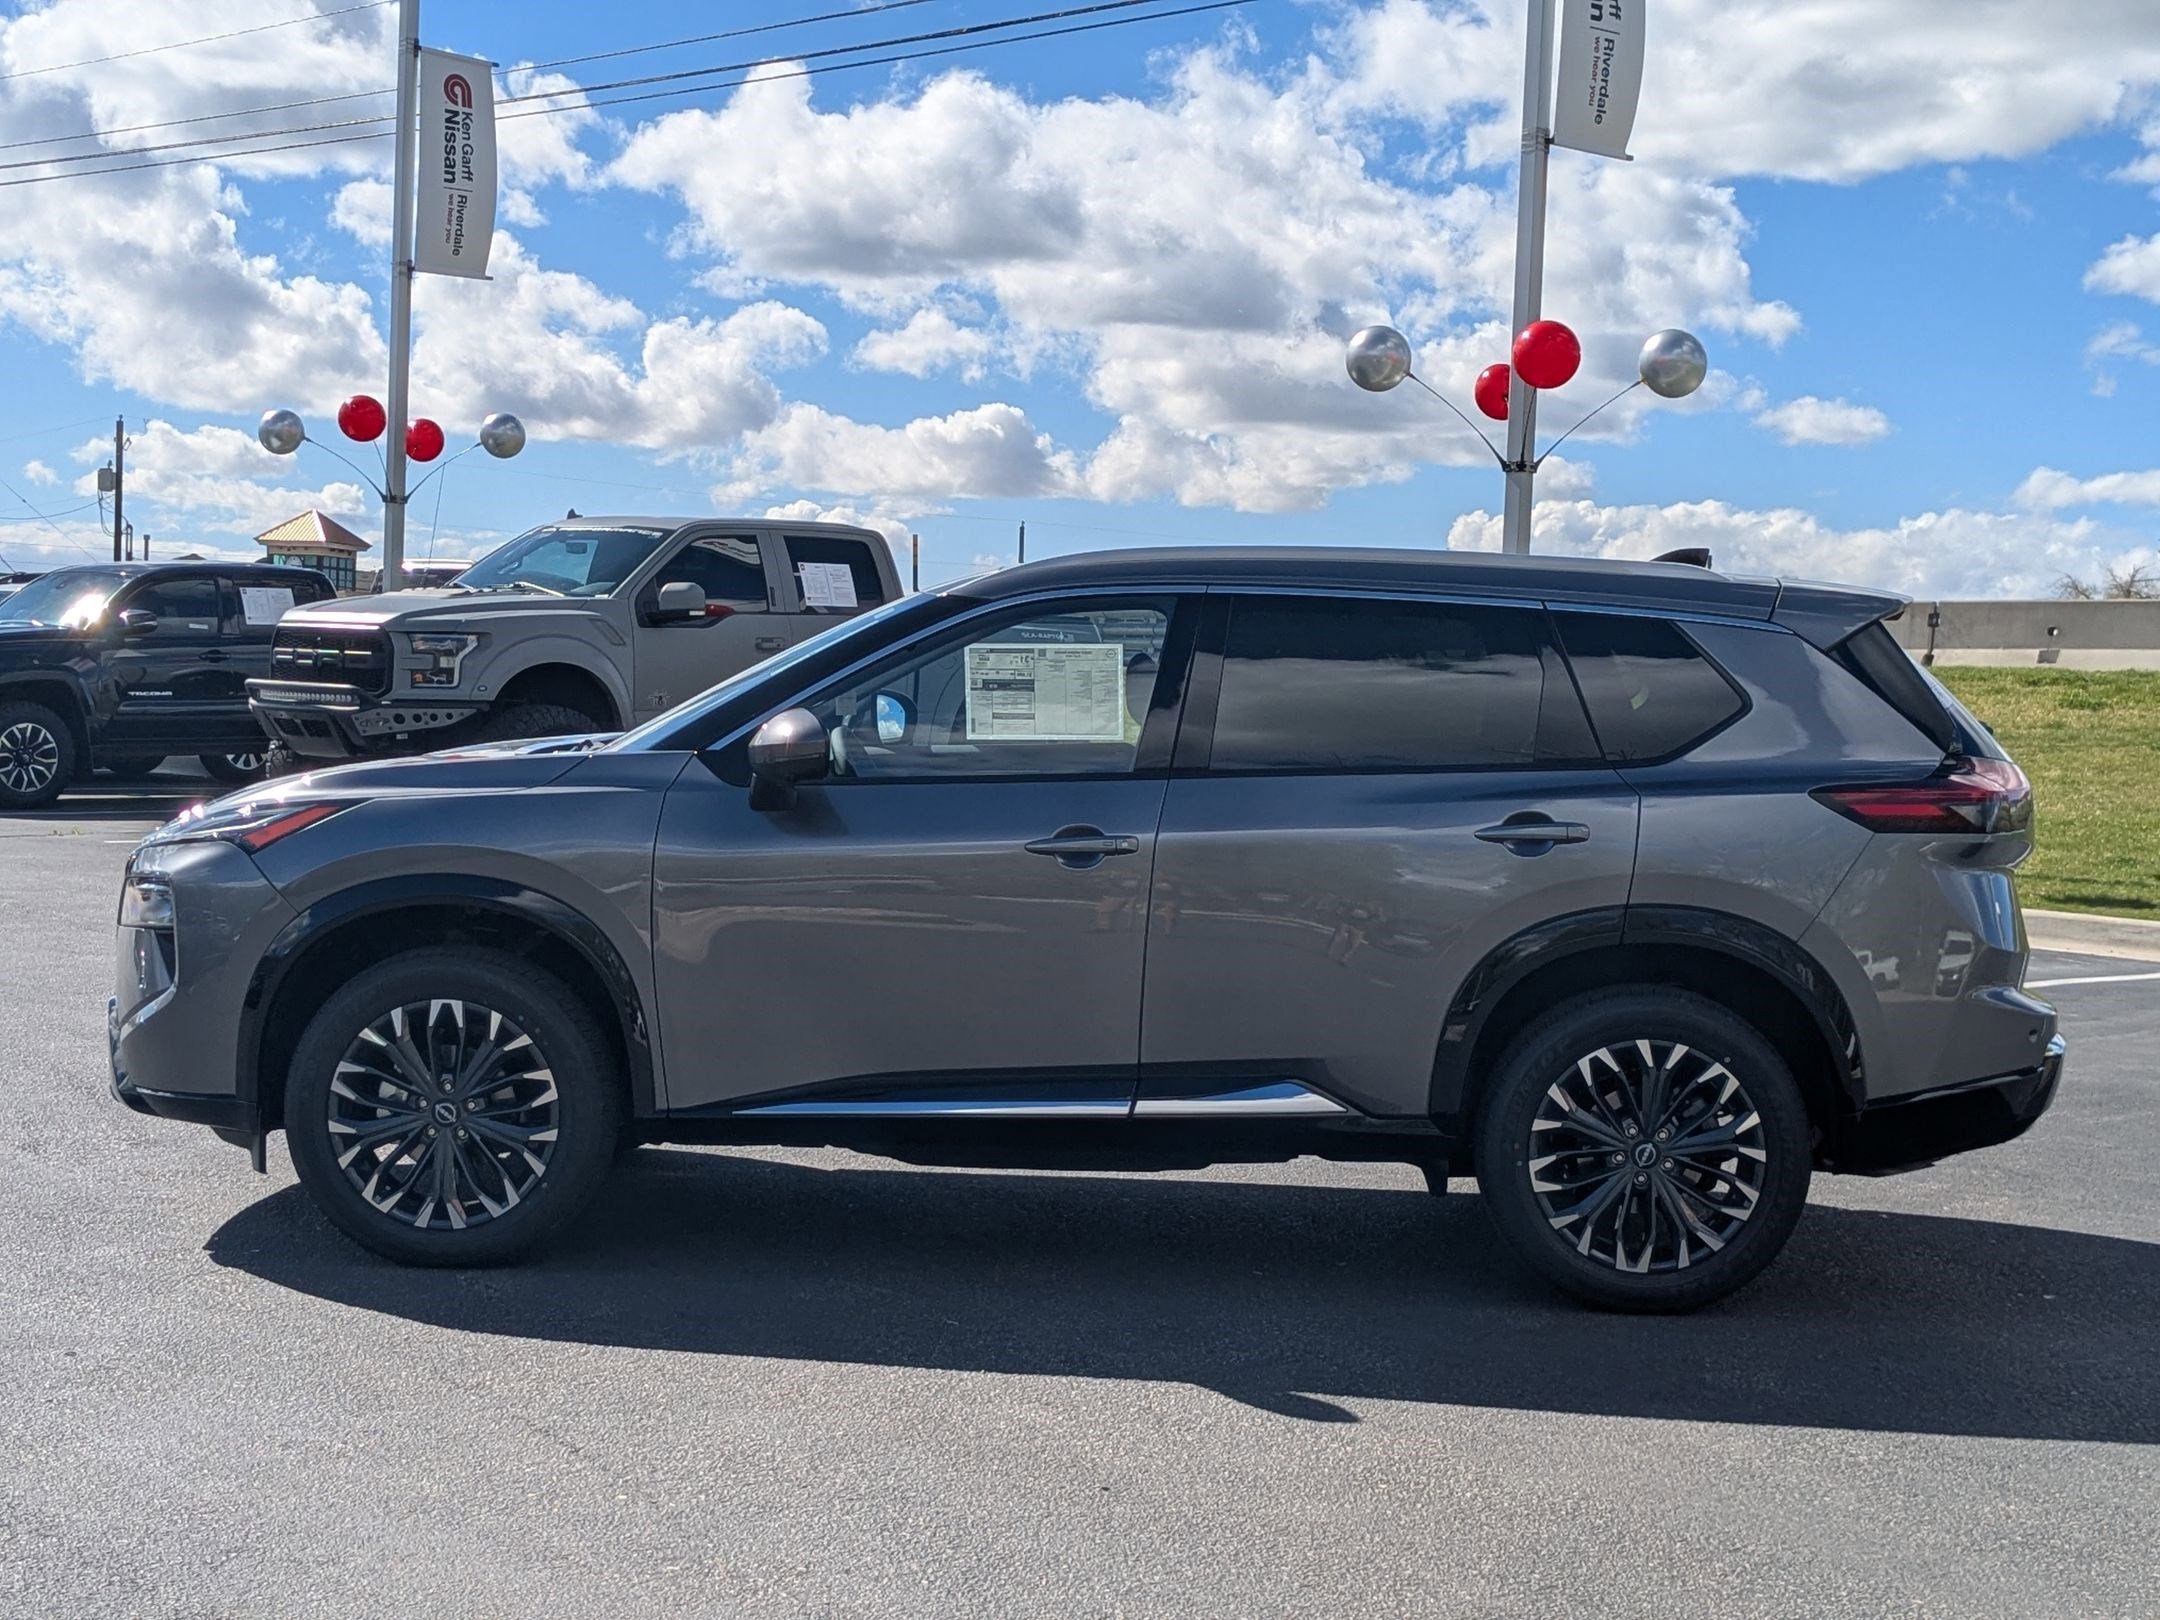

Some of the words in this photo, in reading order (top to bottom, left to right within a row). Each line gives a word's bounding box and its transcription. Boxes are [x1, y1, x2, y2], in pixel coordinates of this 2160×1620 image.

[1593, 36, 1600, 54] we
[1591, 55, 1600, 82] hear
[1594, 38, 1615, 125] Riverdale
[1588, 84, 1597, 106] you
[461, 111, 473, 141] Ken
[443, 108, 460, 184] Nissan
[461, 143, 474, 183] Garff
[452, 194, 468, 256] Riverdale
